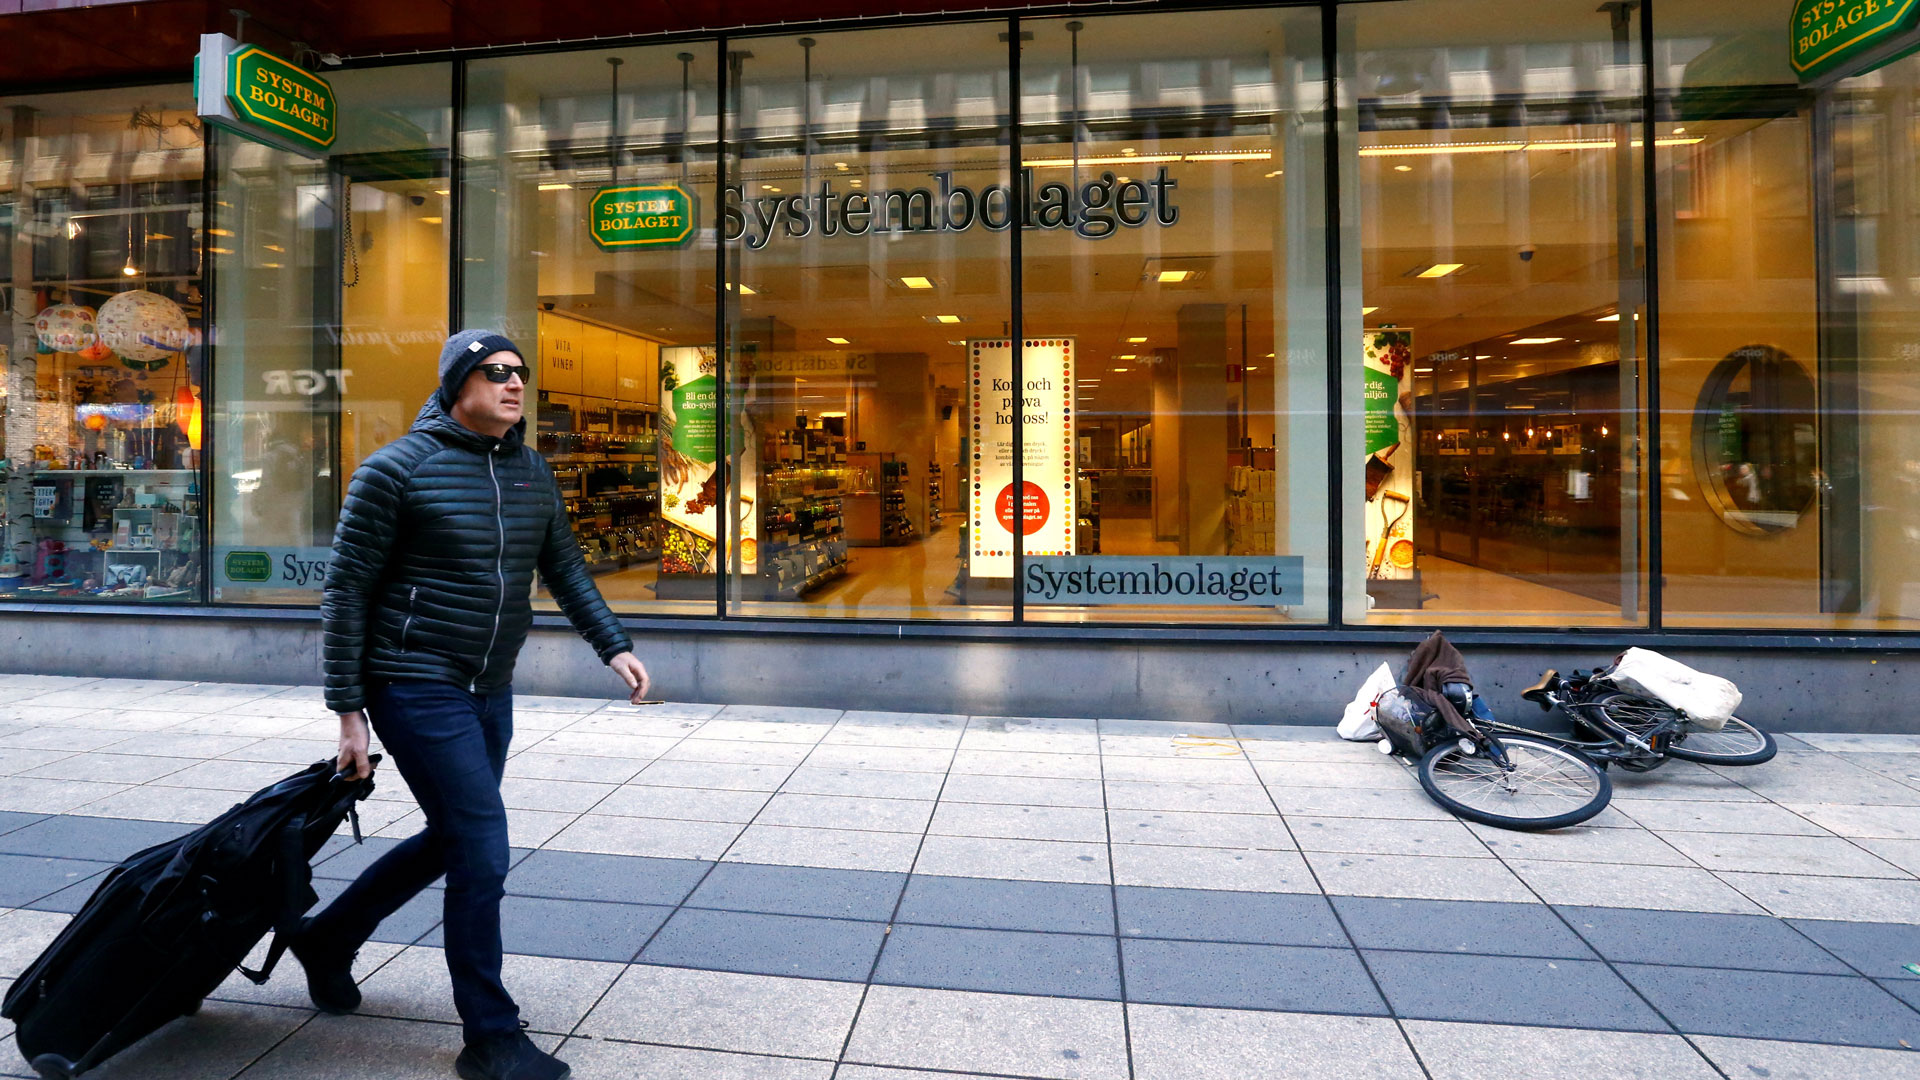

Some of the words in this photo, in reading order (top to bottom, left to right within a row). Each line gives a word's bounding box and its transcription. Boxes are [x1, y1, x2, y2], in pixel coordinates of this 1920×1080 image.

[1801, 0, 1847, 29] SYS
[256, 67, 326, 111] SYSTEM
[249, 84, 329, 131] BOLAGET
[604, 200, 675, 215] SYSTEM
[722, 165, 1178, 251] Systembolaget
[600, 215, 681, 231] BOLAGET
[555, 339, 571, 352] VITA
[553, 357, 573, 371] VINER
[1027, 377, 1051, 391] och
[1369, 381, 1385, 390] dig.
[685, 392, 696, 401] Bli
[708, 392, 717, 401] de
[995, 411, 1016, 424] ho
[1023, 411, 1049, 424] oss!
[232, 559, 265, 567] SYSTEM
[282, 553, 328, 586] Sys
[1026, 563, 1283, 601] Systembolaget
